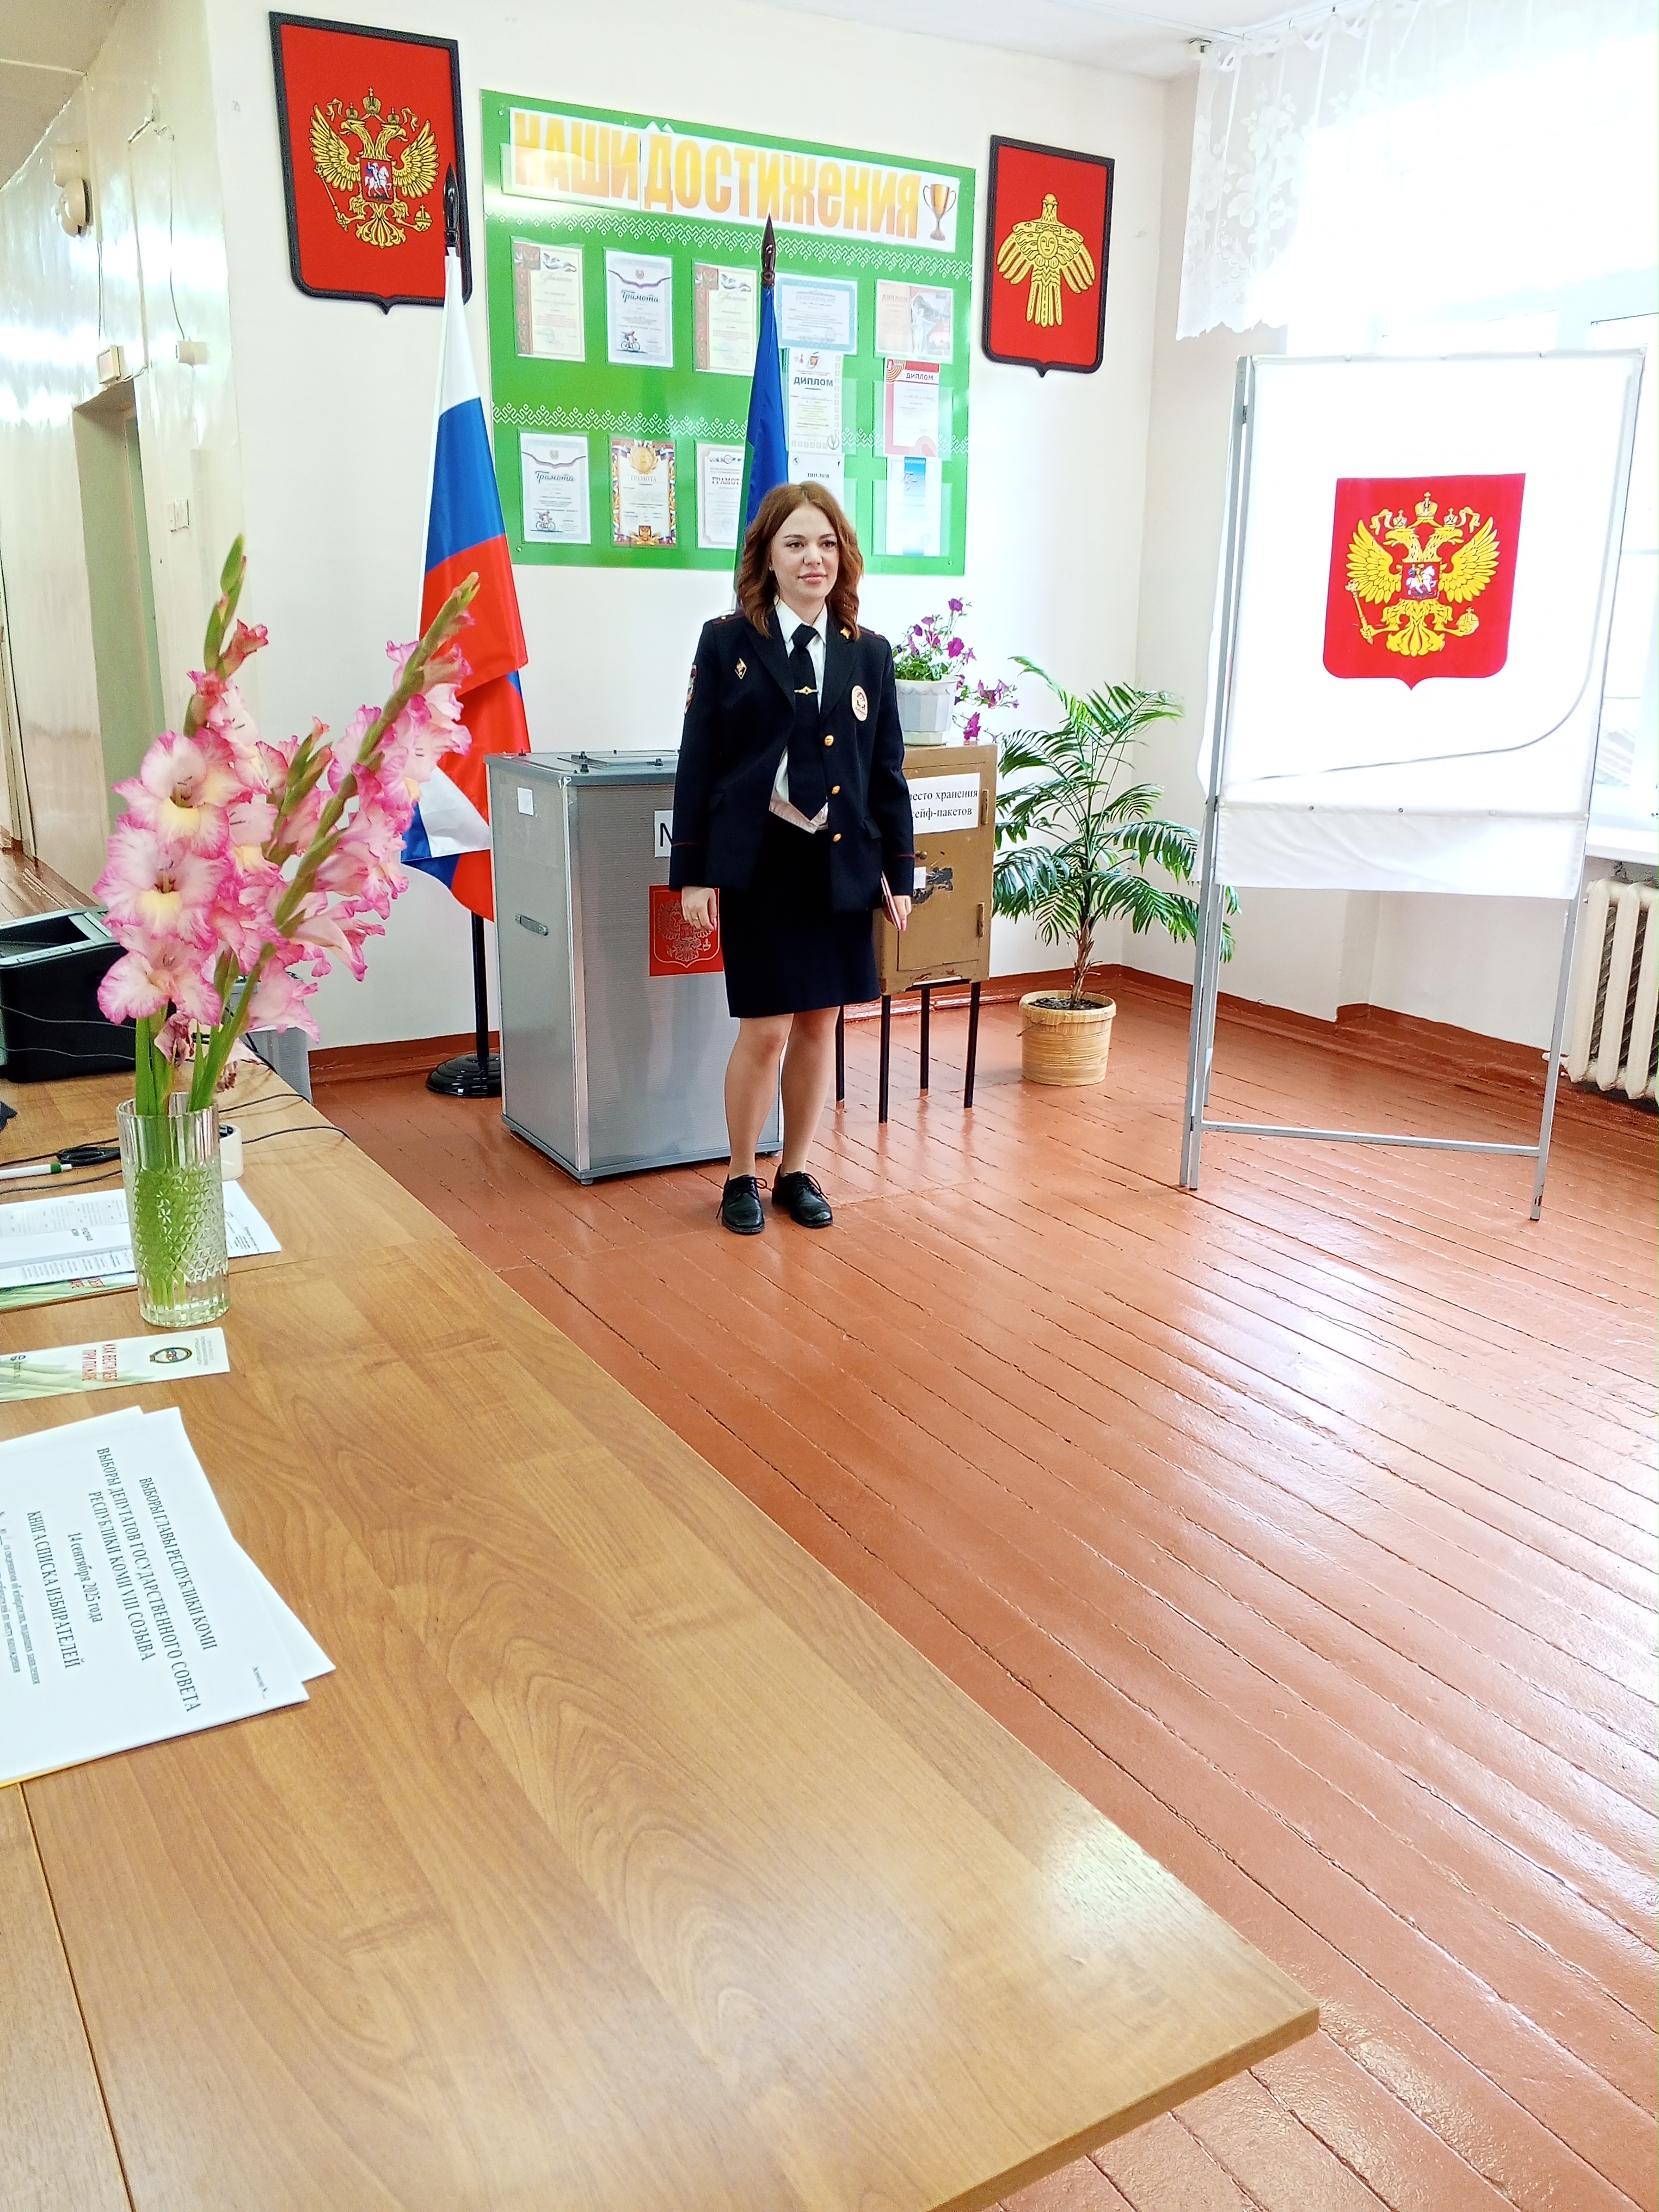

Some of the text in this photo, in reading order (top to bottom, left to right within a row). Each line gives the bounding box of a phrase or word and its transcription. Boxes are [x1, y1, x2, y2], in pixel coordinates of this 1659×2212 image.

[514, 112, 638, 201] НАШИ
[622, 290, 659, 303] Грамота
[794, 377, 833, 386] ДИПЛОМ
[535, 471, 574, 483] Грамота
[712, 477, 741, 485] ГРАМОТ
[936, 790, 978, 802] хранения
[27, 1511, 85, 1669] КНИГА СПИСКА ИЗБИРАТЕЛЕЙ
[68, 1532, 103, 1623] 14 сентября 2025 года
[89, 1491, 156, 1661] РЕСПУБЛИКИ КОМИ VIII СОЗЫВА
[97, 1447, 201, 1712] ВЫБОРЫ ДЕПУТАТОВ ГОСУДАРСТВЕННОГО СОВЕТА
[139, 1477, 218, 1650] ВЫБОРЫ ГЛАВЫ РЕСПУБЛИКИ КОМИ
